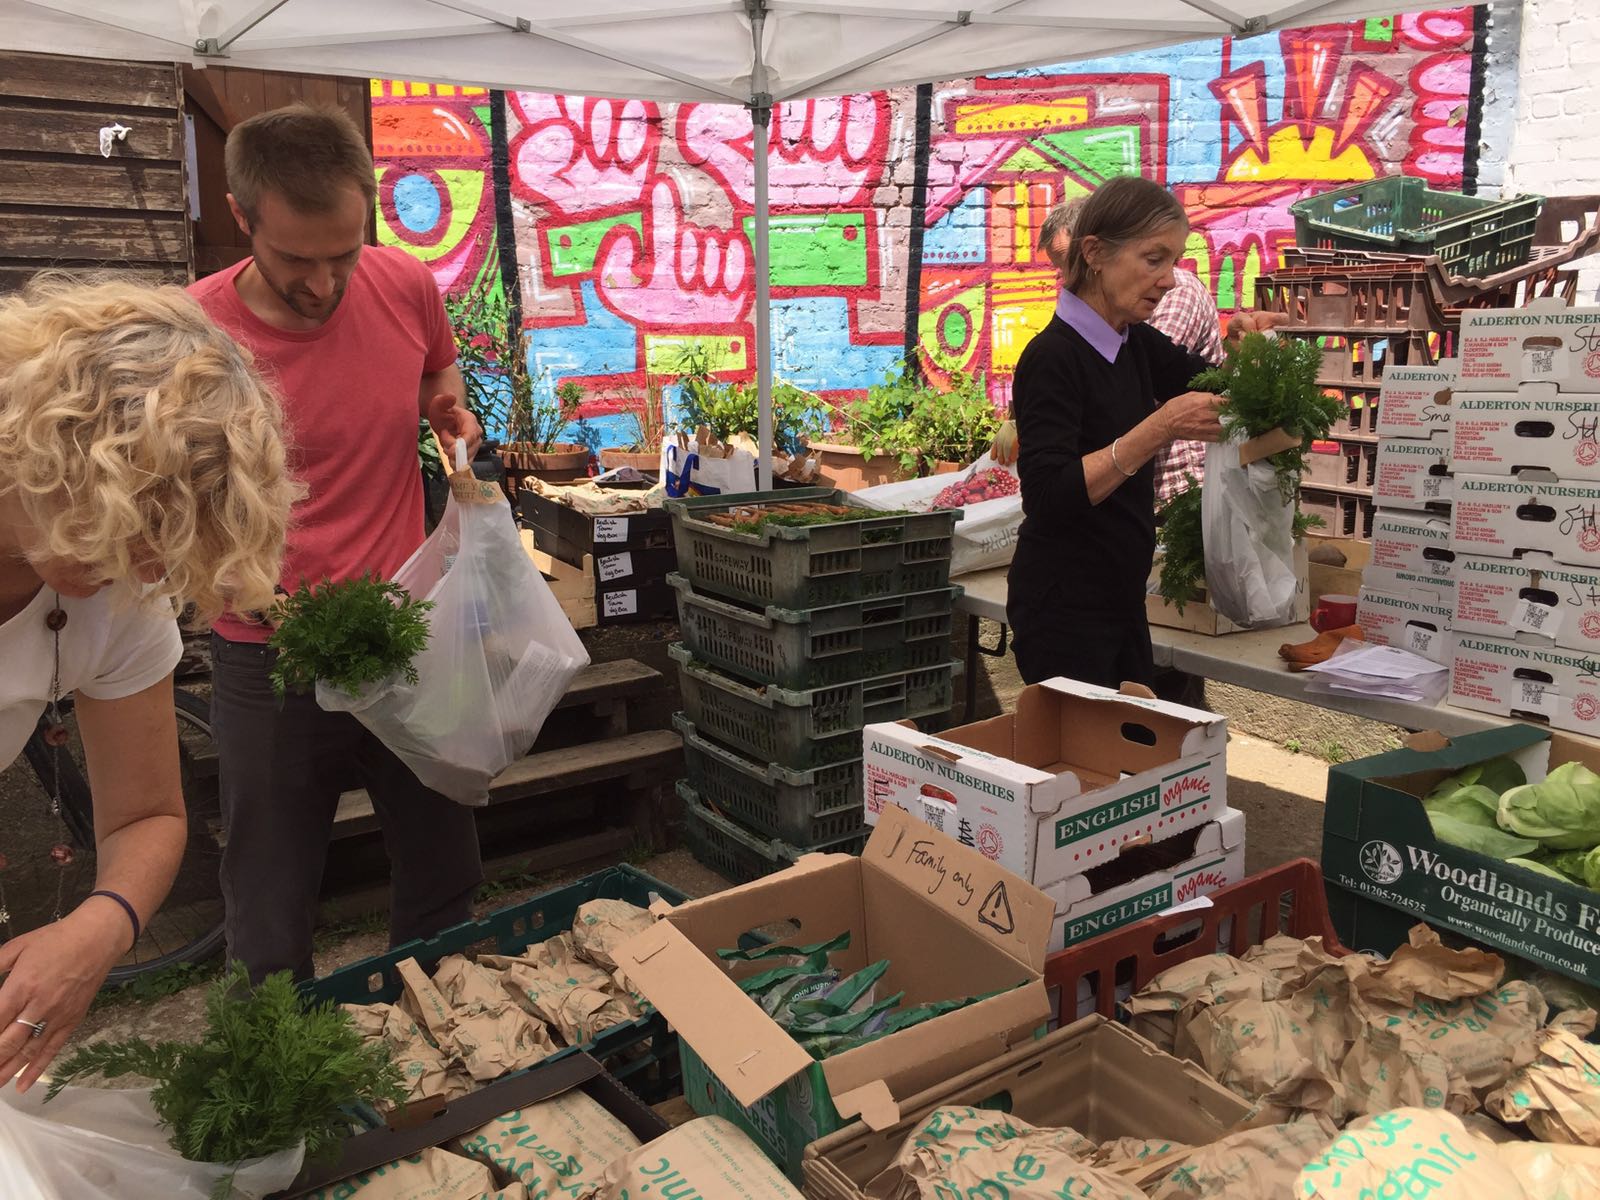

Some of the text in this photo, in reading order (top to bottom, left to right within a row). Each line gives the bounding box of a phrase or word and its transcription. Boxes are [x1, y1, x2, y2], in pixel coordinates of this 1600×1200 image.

[1470, 315, 1541, 326] ALDERTON
[1389, 373, 1449, 382] ALDERTON
[1460, 401, 1531, 410] ALDERTON
[1384, 445, 1443, 456] ALDERTON
[1461, 481, 1533, 494] ALDERTON
[1380, 523, 1438, 538] ALDERTON
[1363, 594, 1420, 611] ALDERTON
[1459, 639, 1530, 659] ALDERTON
[870, 741, 934, 772] ALDERTON
[937, 764, 1015, 802] NURSERIES
[1059, 776, 1211, 840] ENGLISH organic
[905, 841, 974, 906] Family only
[1406, 845, 1568, 922] Woodlands
[1068, 870, 1227, 940] ENGLISH organic
[1339, 874, 1427, 912] Tel: 01205-724525
[1441, 885, 1532, 932] Organically
[1447, 915, 1588, 976] www.woodlandsfarm.co.uk
